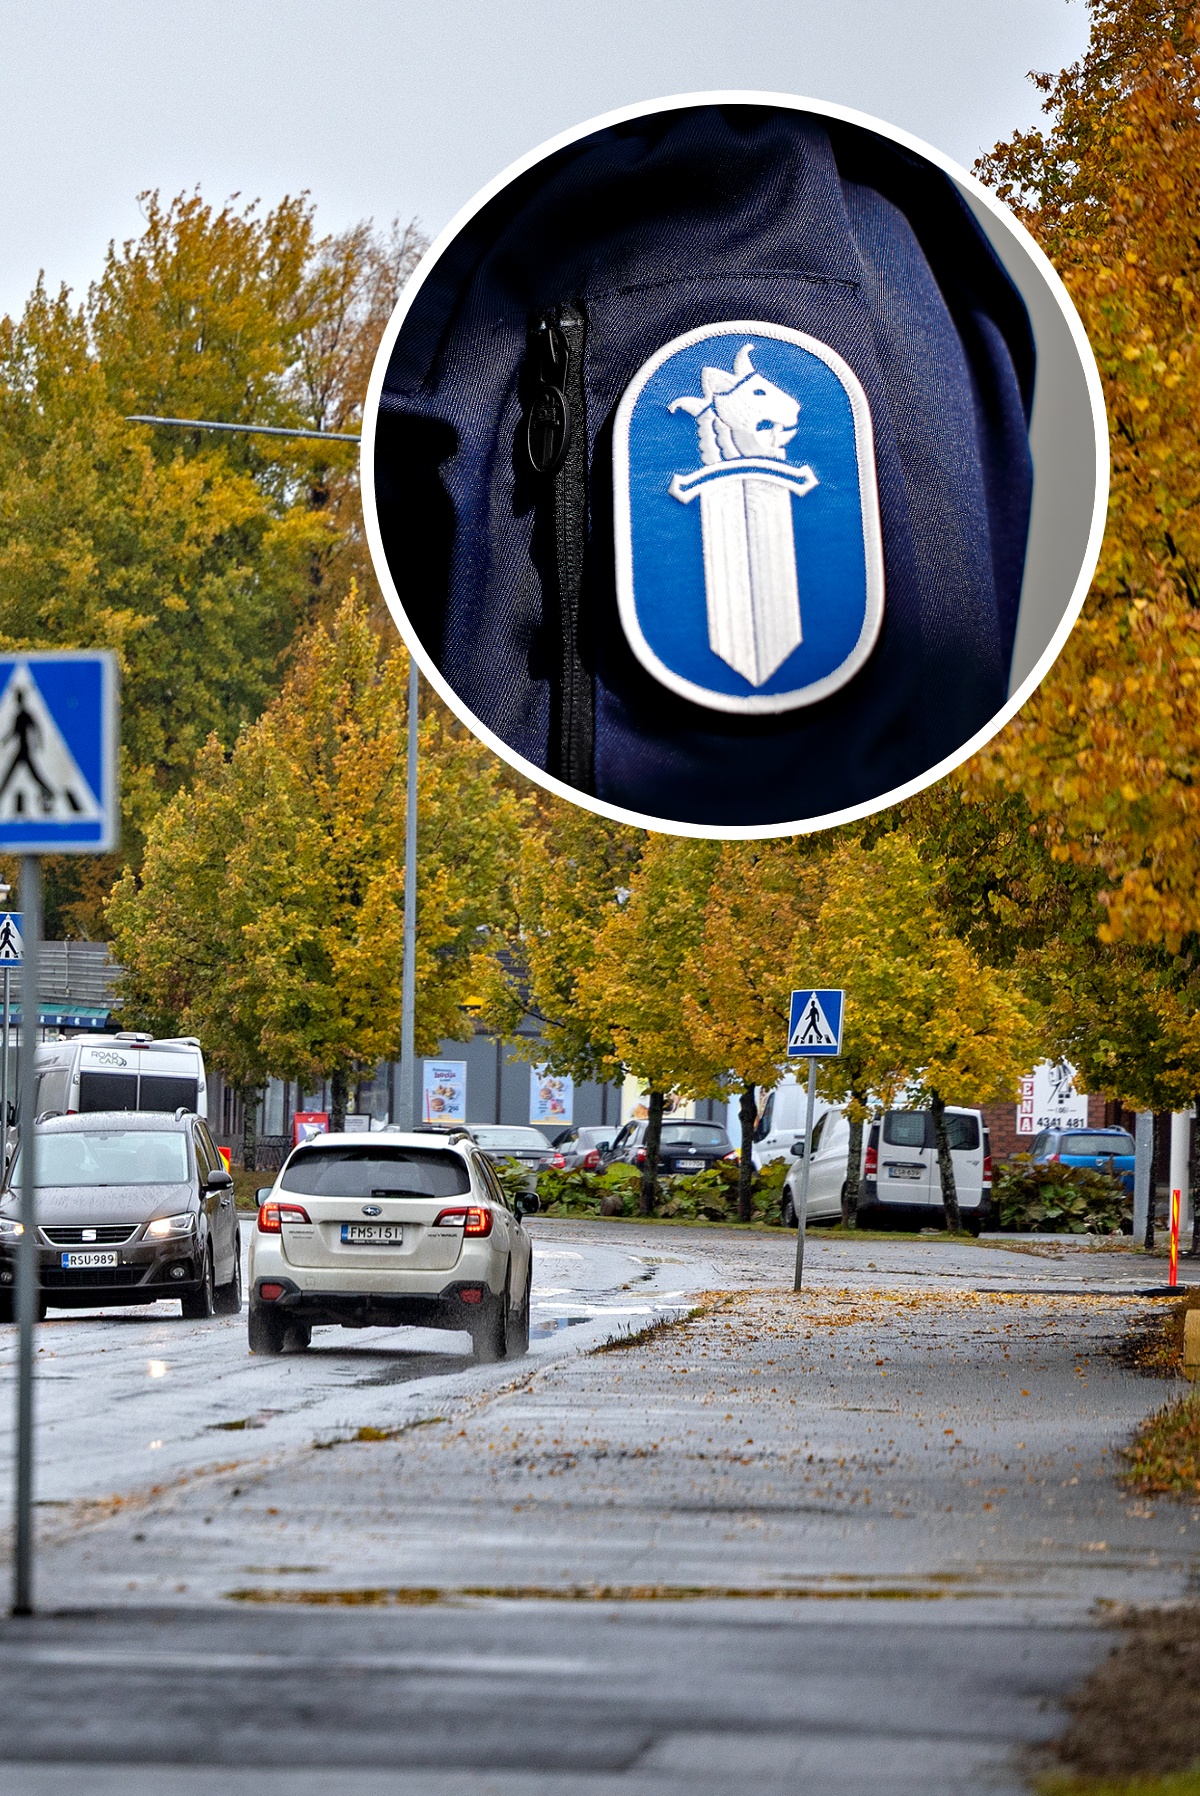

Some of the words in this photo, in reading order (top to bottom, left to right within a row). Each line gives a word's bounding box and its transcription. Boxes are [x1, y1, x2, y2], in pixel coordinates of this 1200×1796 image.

[91, 1050, 119, 1060] ROAD
[1020, 1081, 1034, 1132] ENA
[1066, 1117, 1085, 1128] 481
[70, 1254, 115, 1265] RSU-989
